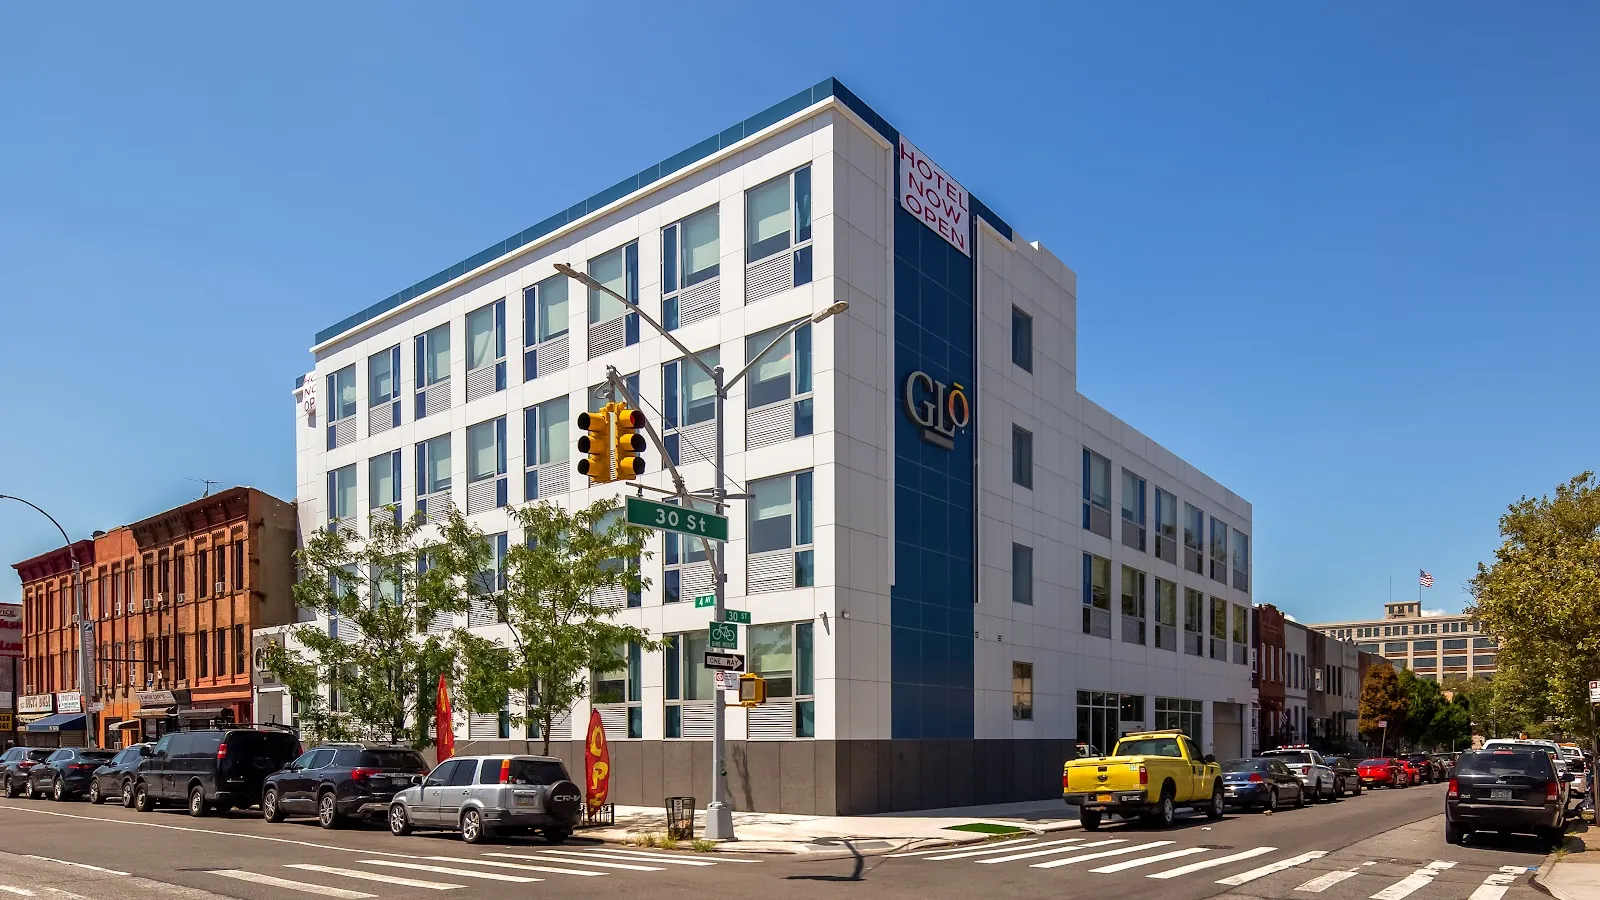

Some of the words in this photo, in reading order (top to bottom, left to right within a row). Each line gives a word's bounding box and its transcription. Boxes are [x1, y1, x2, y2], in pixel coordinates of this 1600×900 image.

[901, 142, 967, 212] HOTEL
[908, 171, 961, 224] NOW
[905, 194, 964, 249] OPEN
[655, 508, 679, 526] 30
[686, 514, 706, 533] St
[698, 597, 704, 606] 4
[704, 595, 711, 603] AV
[728, 611, 738, 621] 30
[553, 794, 580, 802] CR-V
